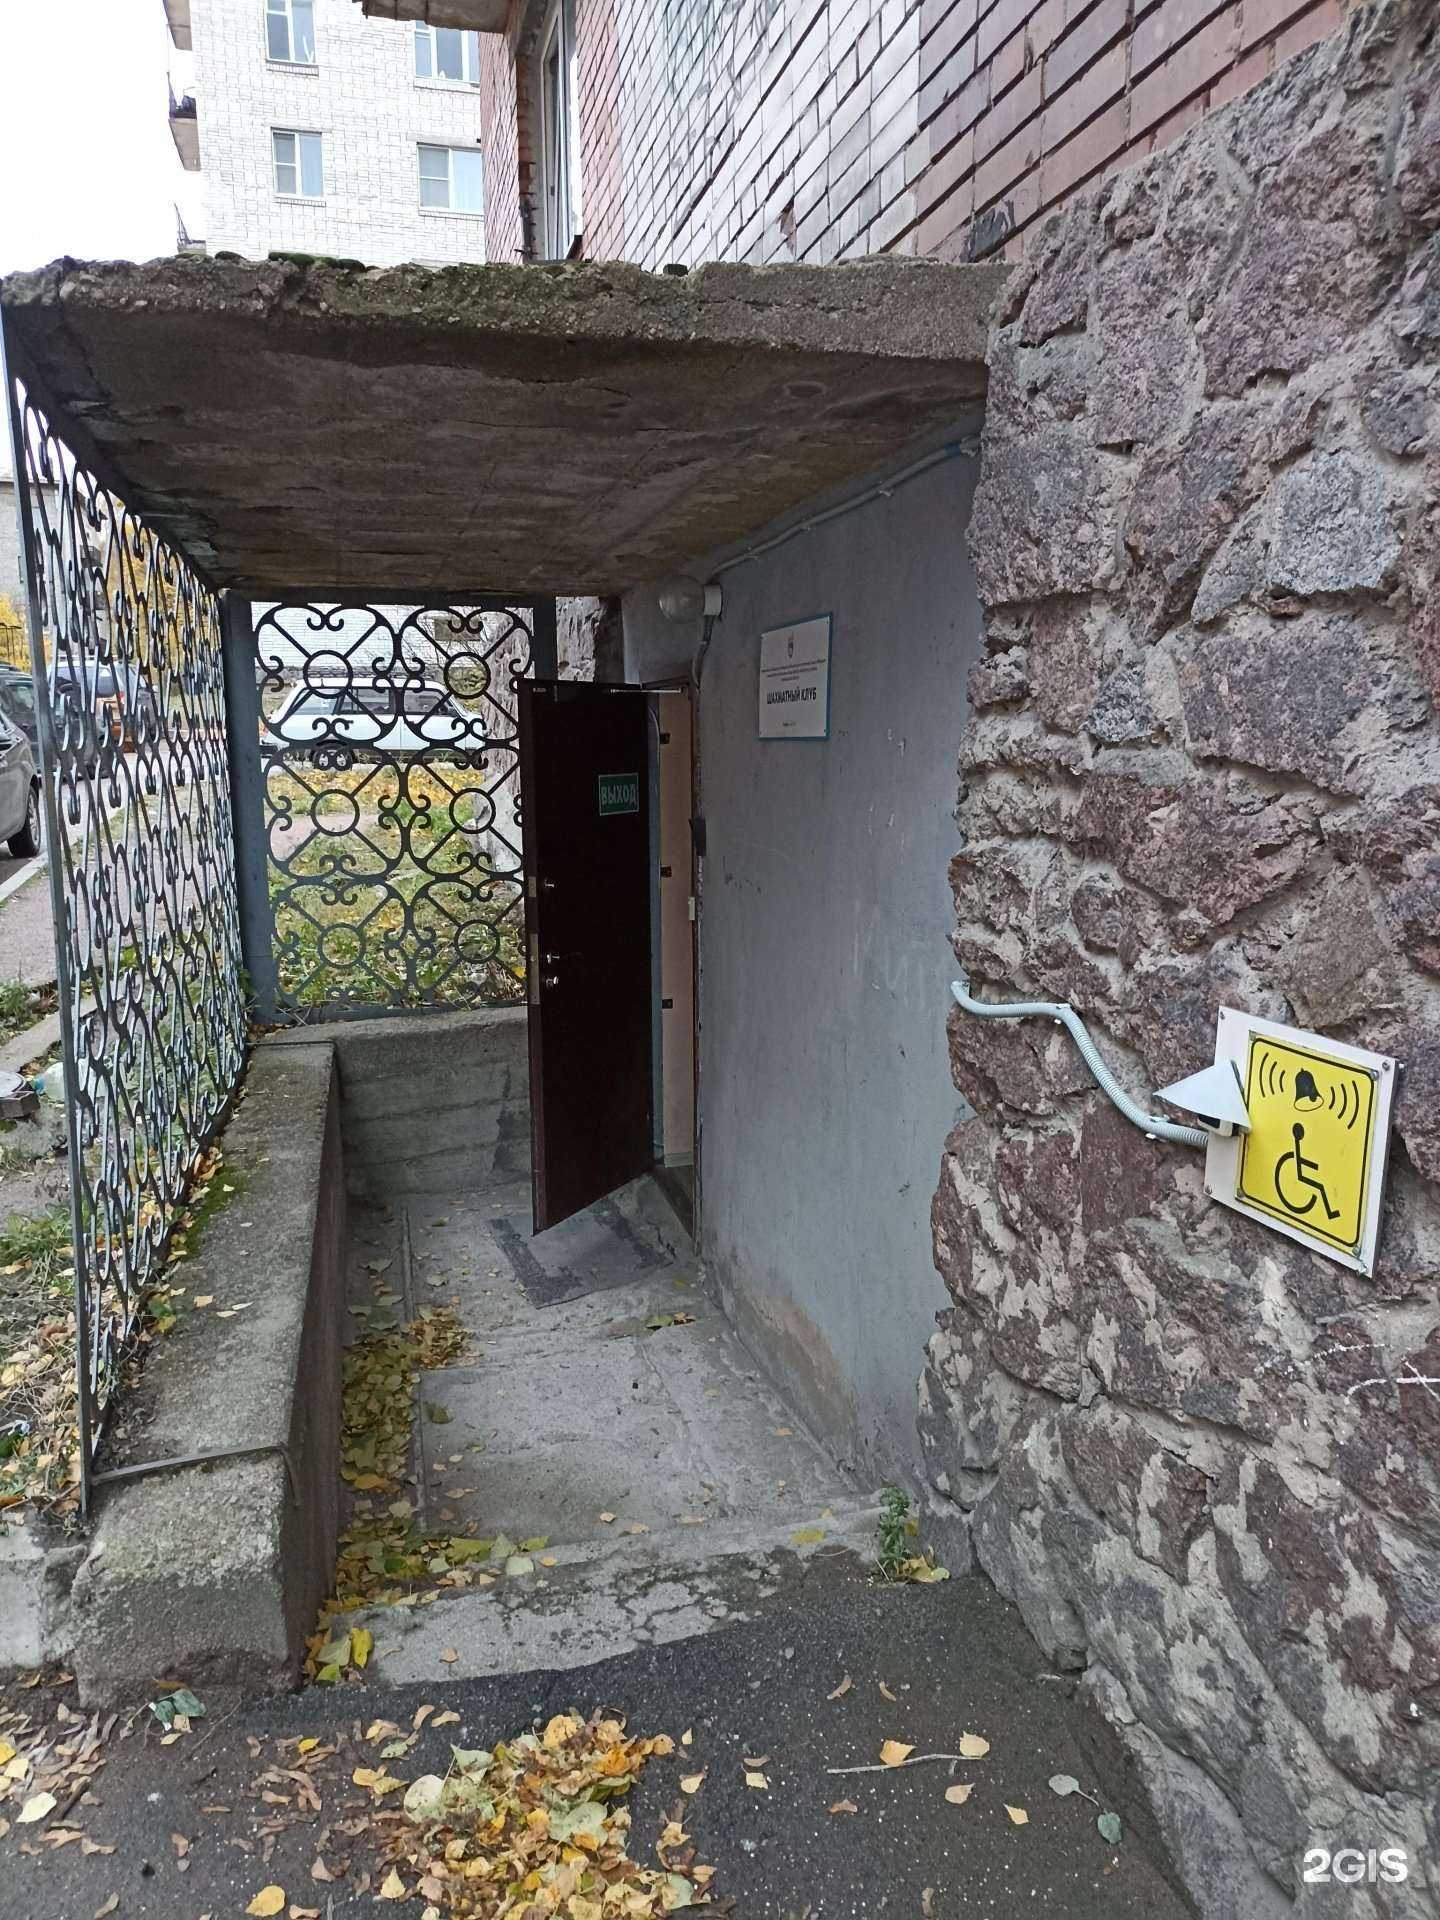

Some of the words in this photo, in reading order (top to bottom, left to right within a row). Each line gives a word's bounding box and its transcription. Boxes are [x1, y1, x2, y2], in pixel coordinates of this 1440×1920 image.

[767, 687, 800, 704] ШАХМАТНЫЙ
[801, 687, 817, 701] КЛУБ
[601, 784, 639, 805] ВЫХОД
